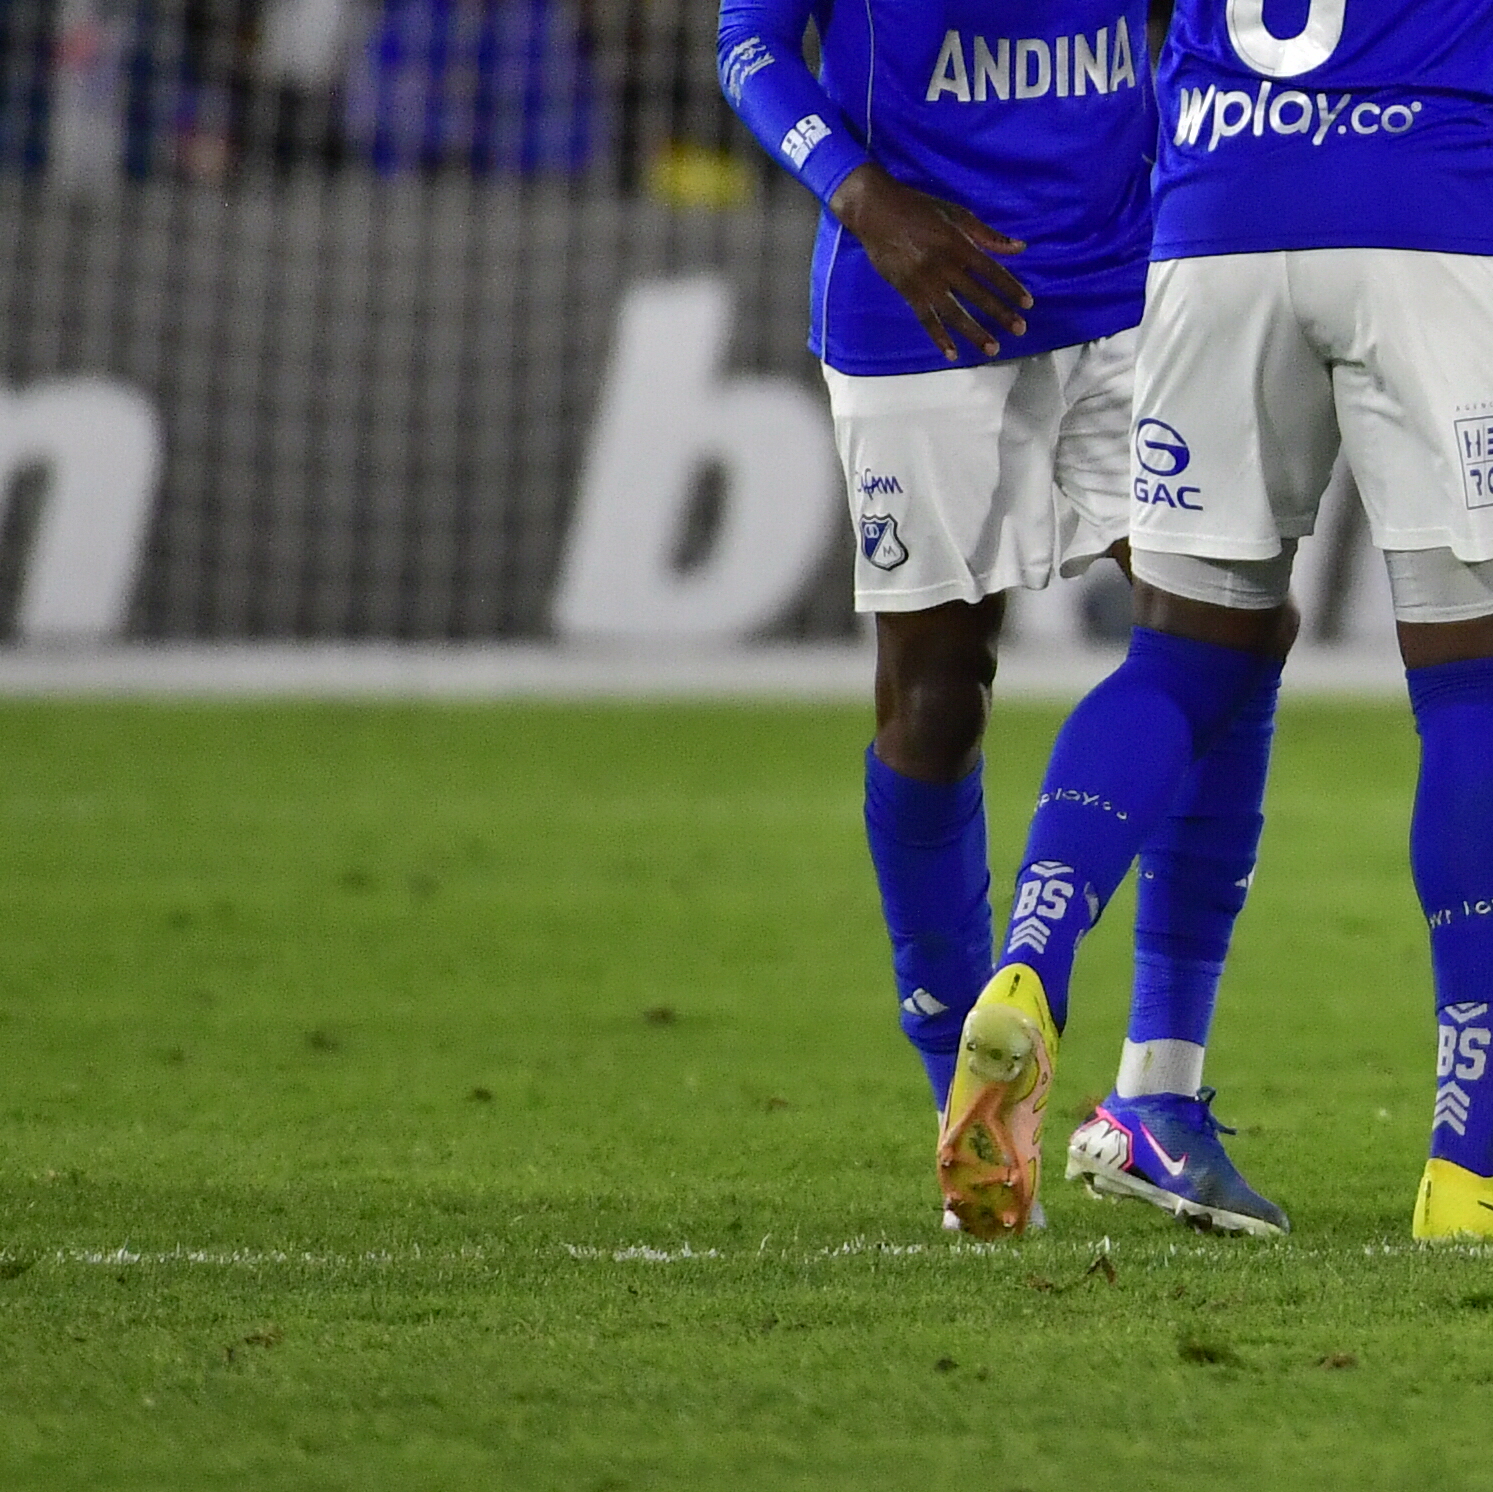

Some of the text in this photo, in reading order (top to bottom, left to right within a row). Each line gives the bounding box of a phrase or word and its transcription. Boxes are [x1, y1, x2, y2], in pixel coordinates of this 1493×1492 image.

[925, 15, 1136, 102] ANDINA
[1134, 476, 1204, 511] GAC
[1033, 787, 1129, 820] play.co
[1012, 878, 1075, 921] BS
[1436, 1024, 1492, 1081] BS
